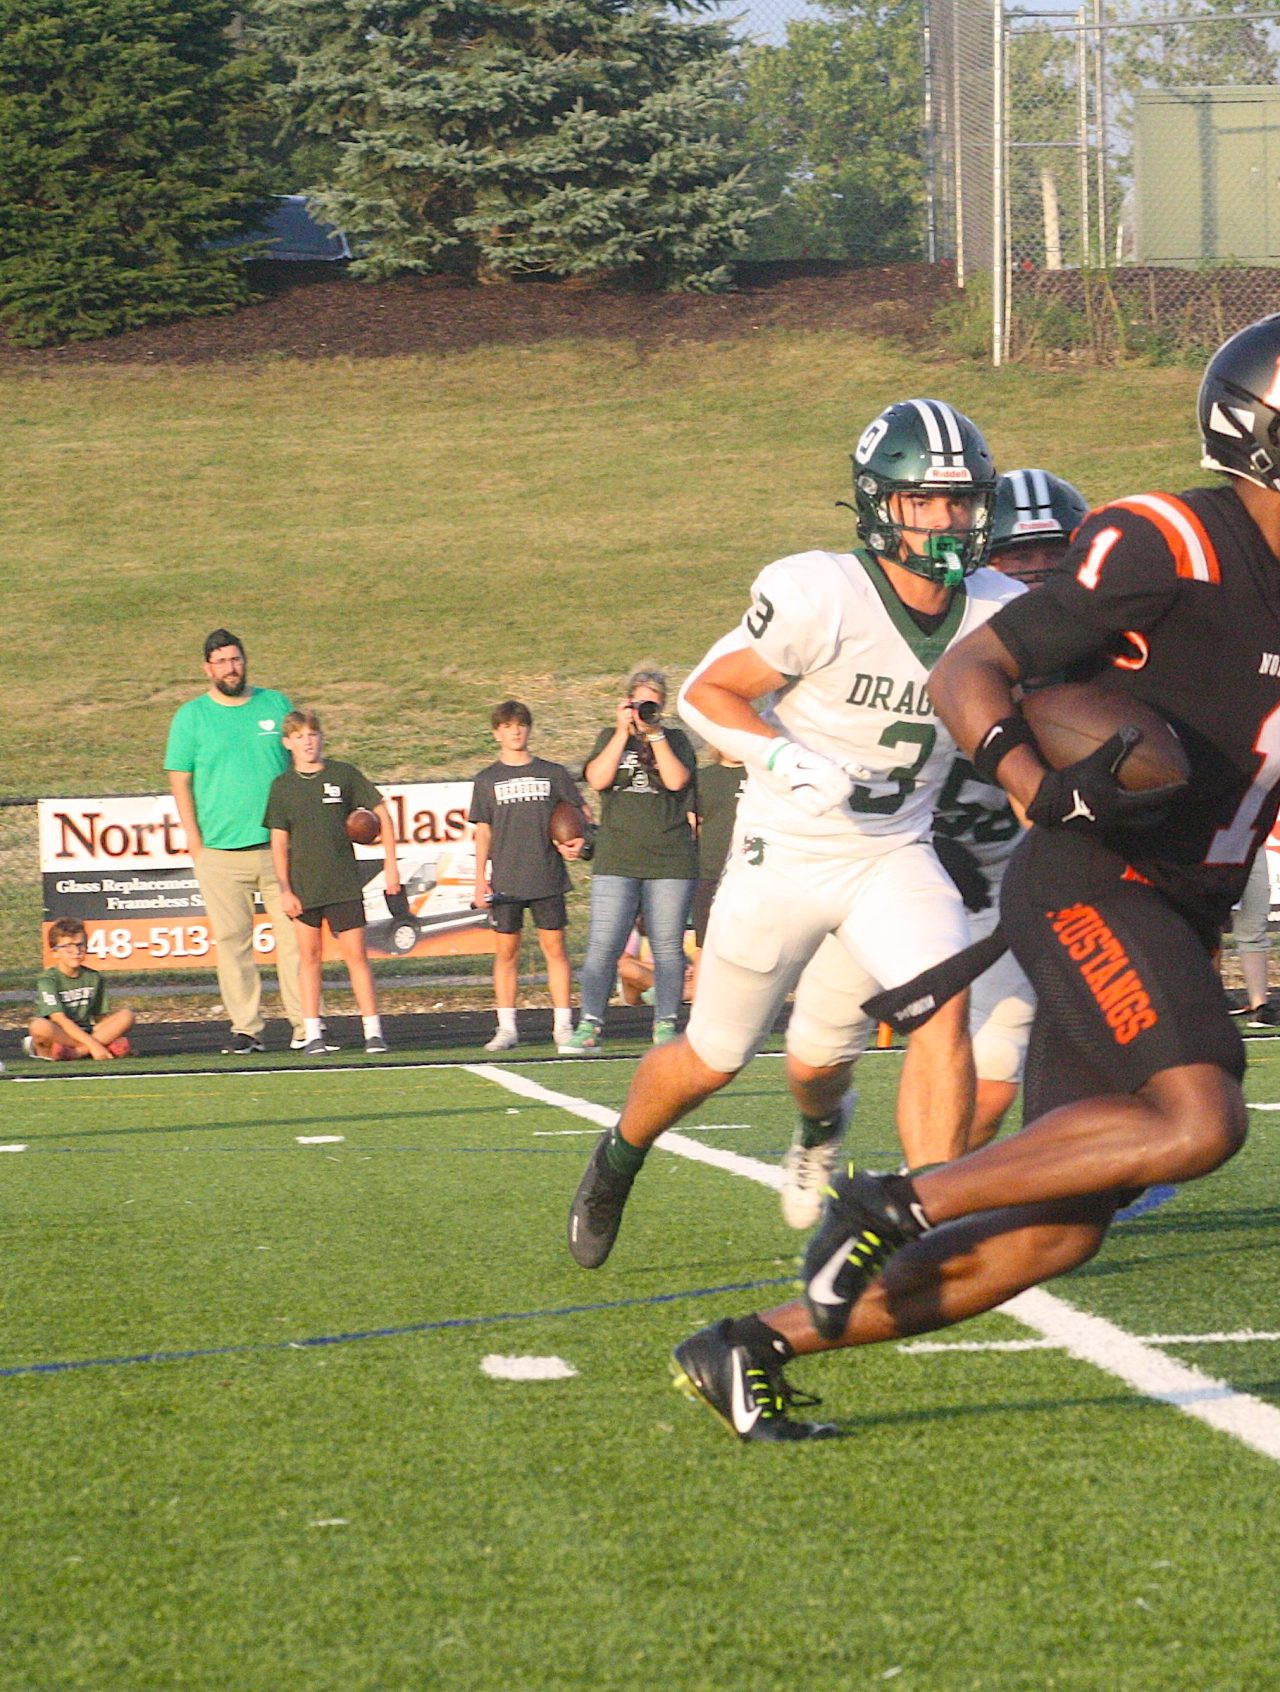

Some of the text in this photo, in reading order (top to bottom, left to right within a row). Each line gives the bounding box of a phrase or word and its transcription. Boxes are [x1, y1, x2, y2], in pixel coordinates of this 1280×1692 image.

[1076, 526, 1124, 590] 1
[747, 592, 774, 640] 3
[846, 673, 941, 718] DRAG
[848, 720, 937, 815] 3
[53, 812, 190, 858] Nort
[55, 879, 100, 894] Glass
[101, 877, 200, 895] Replacemen
